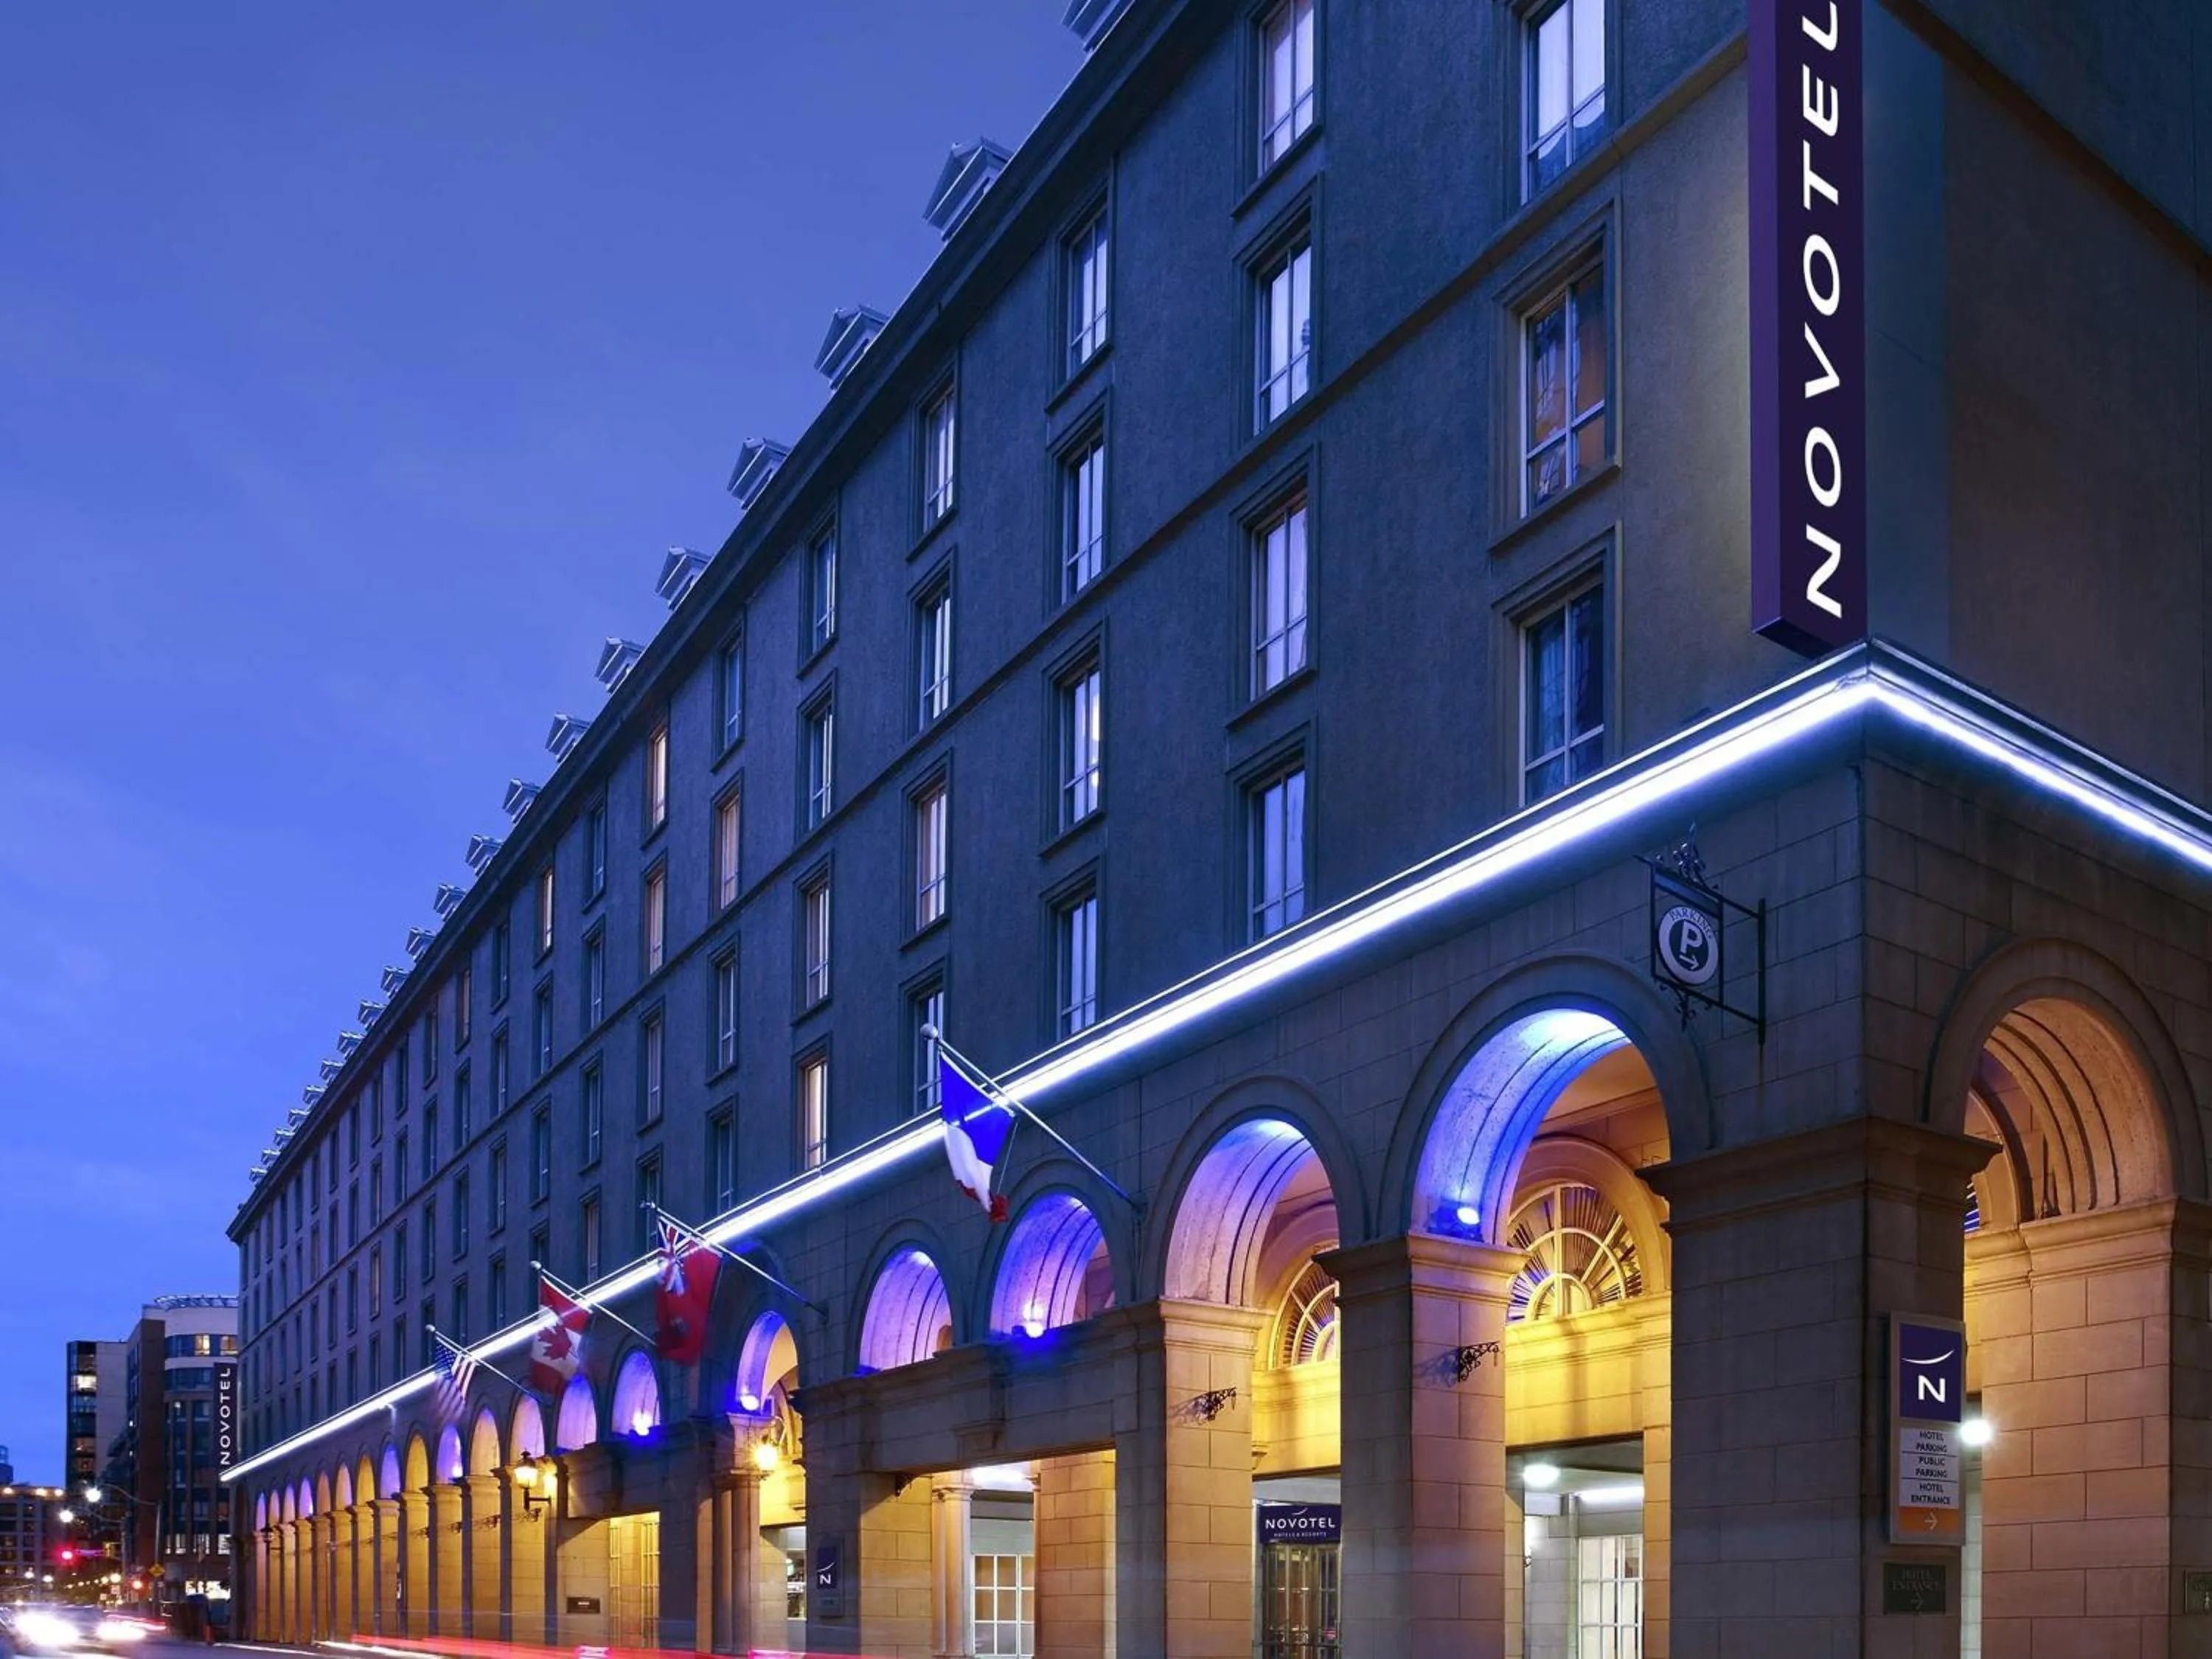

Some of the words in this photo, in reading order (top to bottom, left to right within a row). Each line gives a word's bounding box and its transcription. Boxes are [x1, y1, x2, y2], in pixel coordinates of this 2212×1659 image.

[1802, 1, 1842, 619] NOVOTEL
[1680, 919, 1703, 953] P
[1918, 1374, 1946, 1403] N
[220, 1368, 231, 1465] NOVOTEL
[1919, 1430, 1944, 1441] HOTEL
[1916, 1443, 1947, 1453] PARKING
[1919, 1456, 1946, 1466] PUBLIC
[1915, 1469, 1947, 1478] PARKING
[1919, 1483, 1944, 1493] HOTEL
[1910, 1495, 1950, 1505] ENTRANCE
[1265, 1517, 1336, 1529] NOVOTEL
[819, 1573, 831, 1585] N
